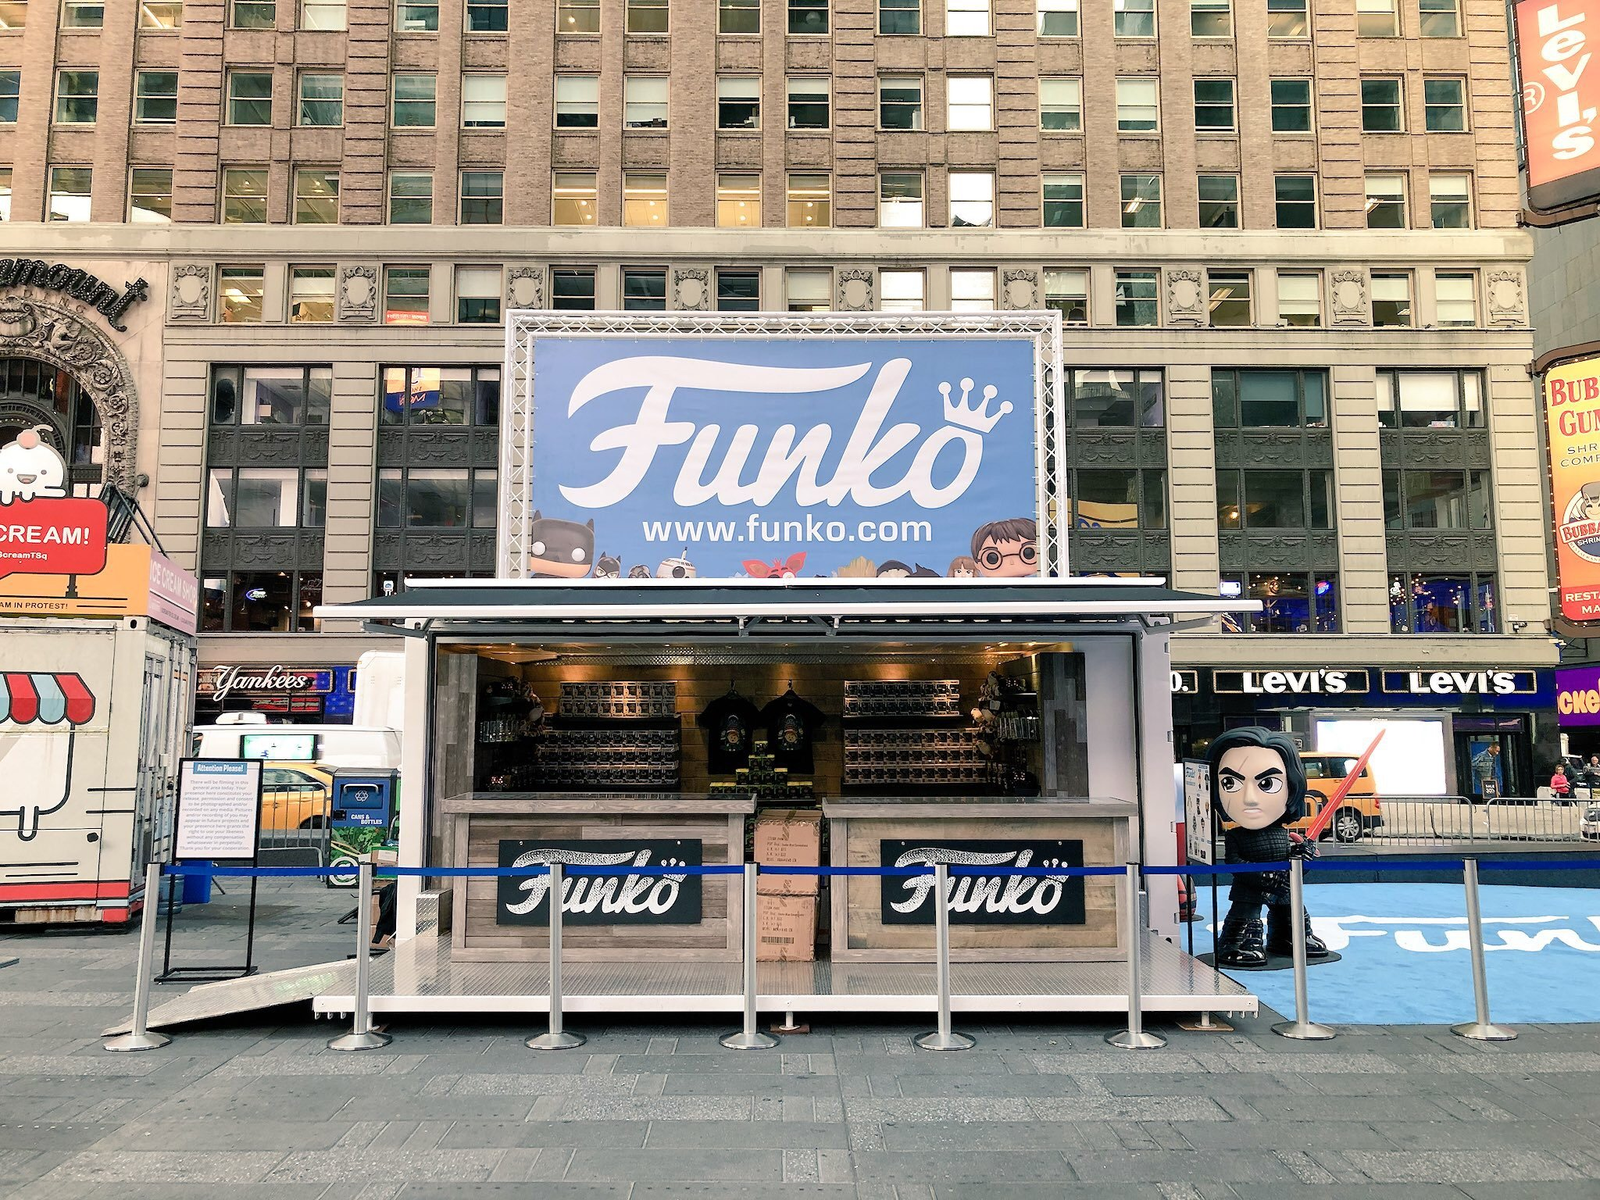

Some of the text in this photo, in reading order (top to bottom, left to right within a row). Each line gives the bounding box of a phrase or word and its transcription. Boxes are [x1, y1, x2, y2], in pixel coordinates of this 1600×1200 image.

[558, 355, 985, 509] Funko
[642, 513, 932, 542] www.funko.com
[1562, 522, 1600, 541] BUBB
[25, 602, 68, 610] PROTEST!
[1565, 591, 1600, 602] REST
[212, 665, 308, 701] Yankees
[196, 763, 244, 772] Attention Please!
[506, 849, 681, 915] Funko
[890, 847, 1063, 915] Funko
